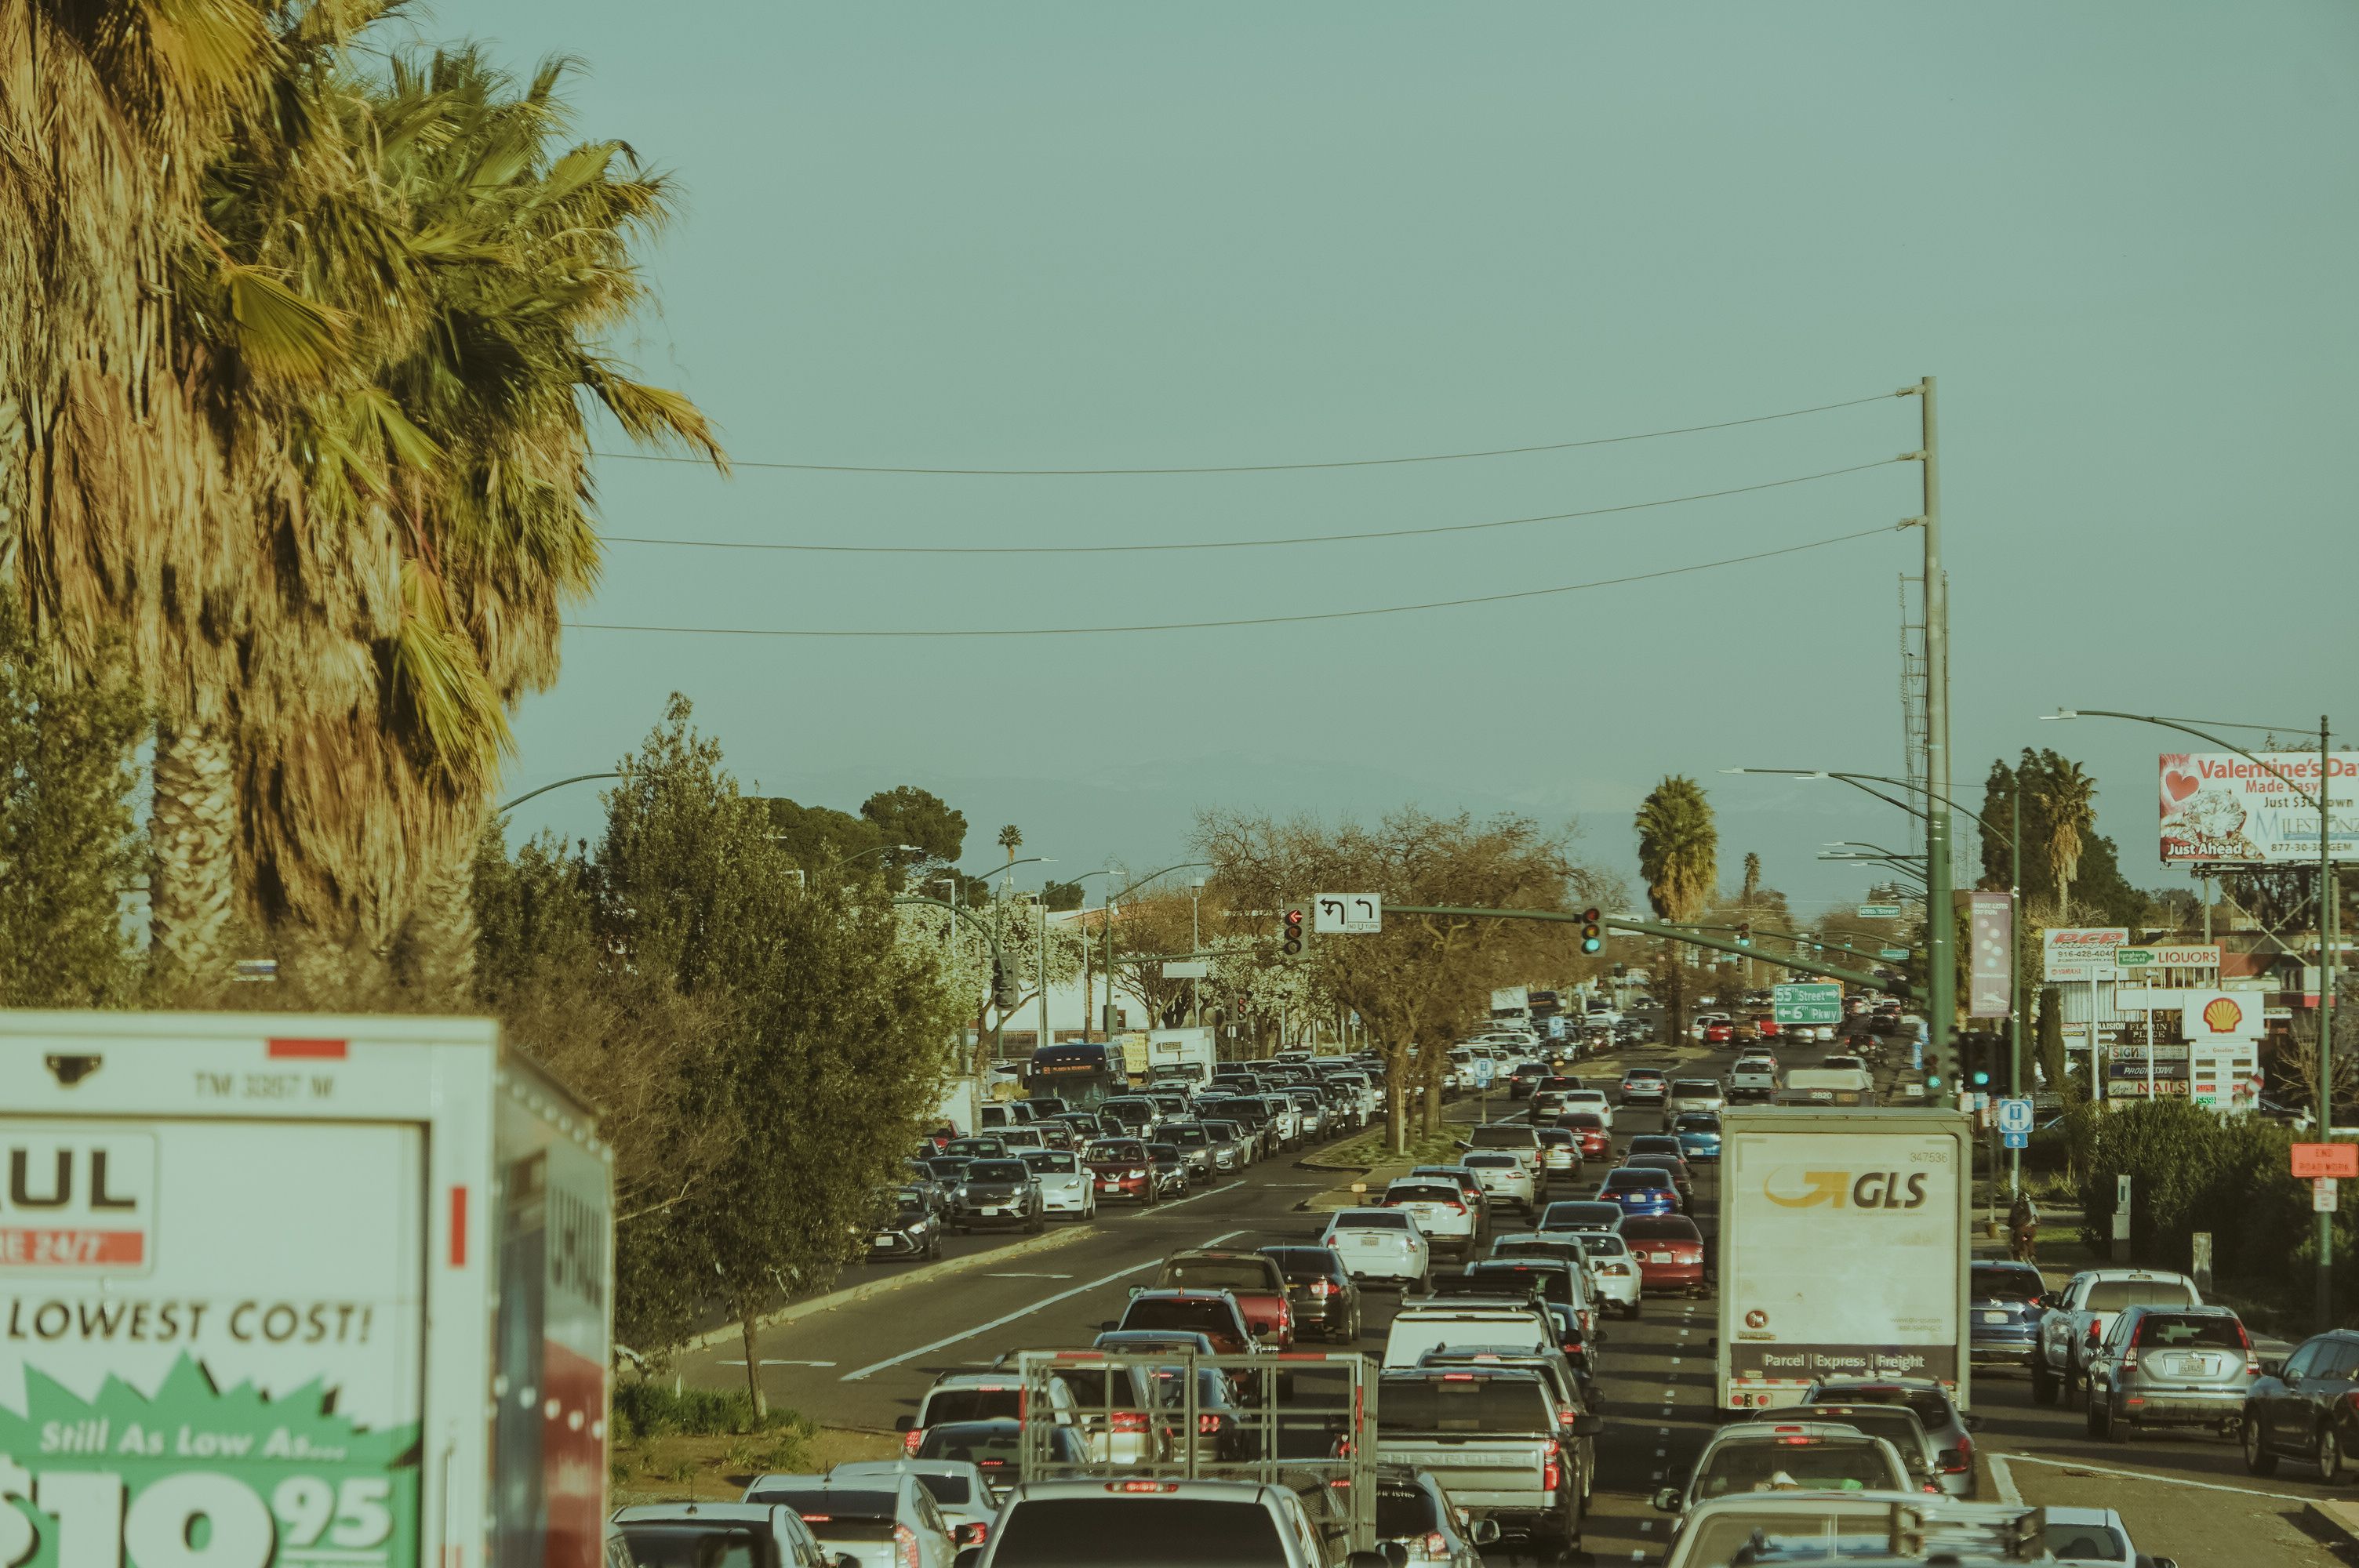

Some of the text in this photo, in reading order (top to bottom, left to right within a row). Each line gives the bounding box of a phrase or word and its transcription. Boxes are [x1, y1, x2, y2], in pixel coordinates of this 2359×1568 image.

[2198, 757, 2359, 779] Valentine's Da
[2246, 779, 2319, 795] Made Easy
[2264, 797, 2288, 808] Just
[2324, 797, 2354, 808] own
[2168, 841, 2243, 855] Just Ahead
[2158, 951, 2218, 964] LIQUORS
[1798, 989, 1826, 1002] Street
[1812, 1008, 1837, 1022] Pkwy
[2114, 1047, 2147, 1058] SIGNS
[2137, 1082, 2186, 1094] NAILS
[1910, 1152, 1948, 1163] 347536
[0, 1149, 136, 1208] UL
[1853, 1172, 1929, 1209] GLS
[6, 1298, 374, 1343] LOWEST COST!
[1765, 1353, 1925, 1371] Parcel Express Freight
[40, 1417, 110, 1455] Still
[119, 1423, 165, 1456] As
[177, 1425, 253, 1457] Low
